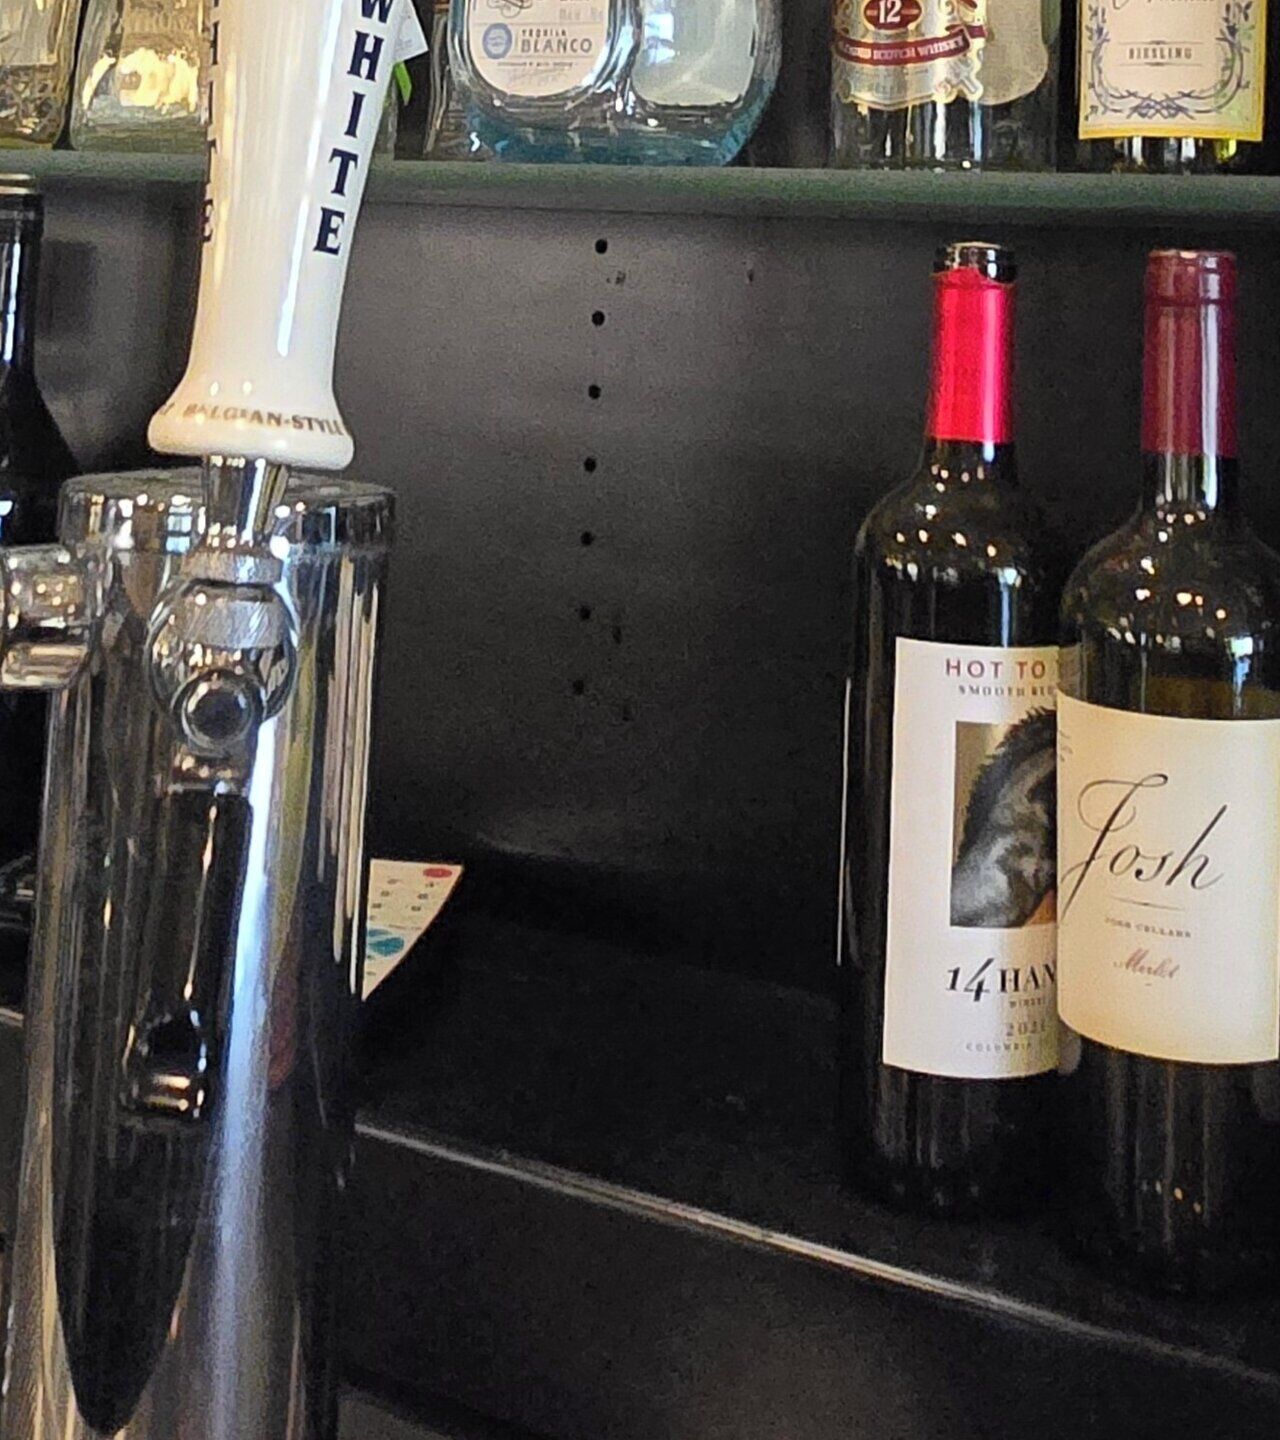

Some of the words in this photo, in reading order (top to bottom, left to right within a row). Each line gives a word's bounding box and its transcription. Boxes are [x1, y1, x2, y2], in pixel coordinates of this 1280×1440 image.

[520, 37, 593, 54] BLANCO
[1128, 47, 1193, 60] RIESLING
[945, 658, 1003, 678] HOT
[1015, 660, 1046, 680] TO
[958, 684, 1025, 697] SMOOTH
[1060, 772, 1226, 921] Josh
[946, 958, 995, 1002] 14
[999, 963, 1056, 994] HAN
